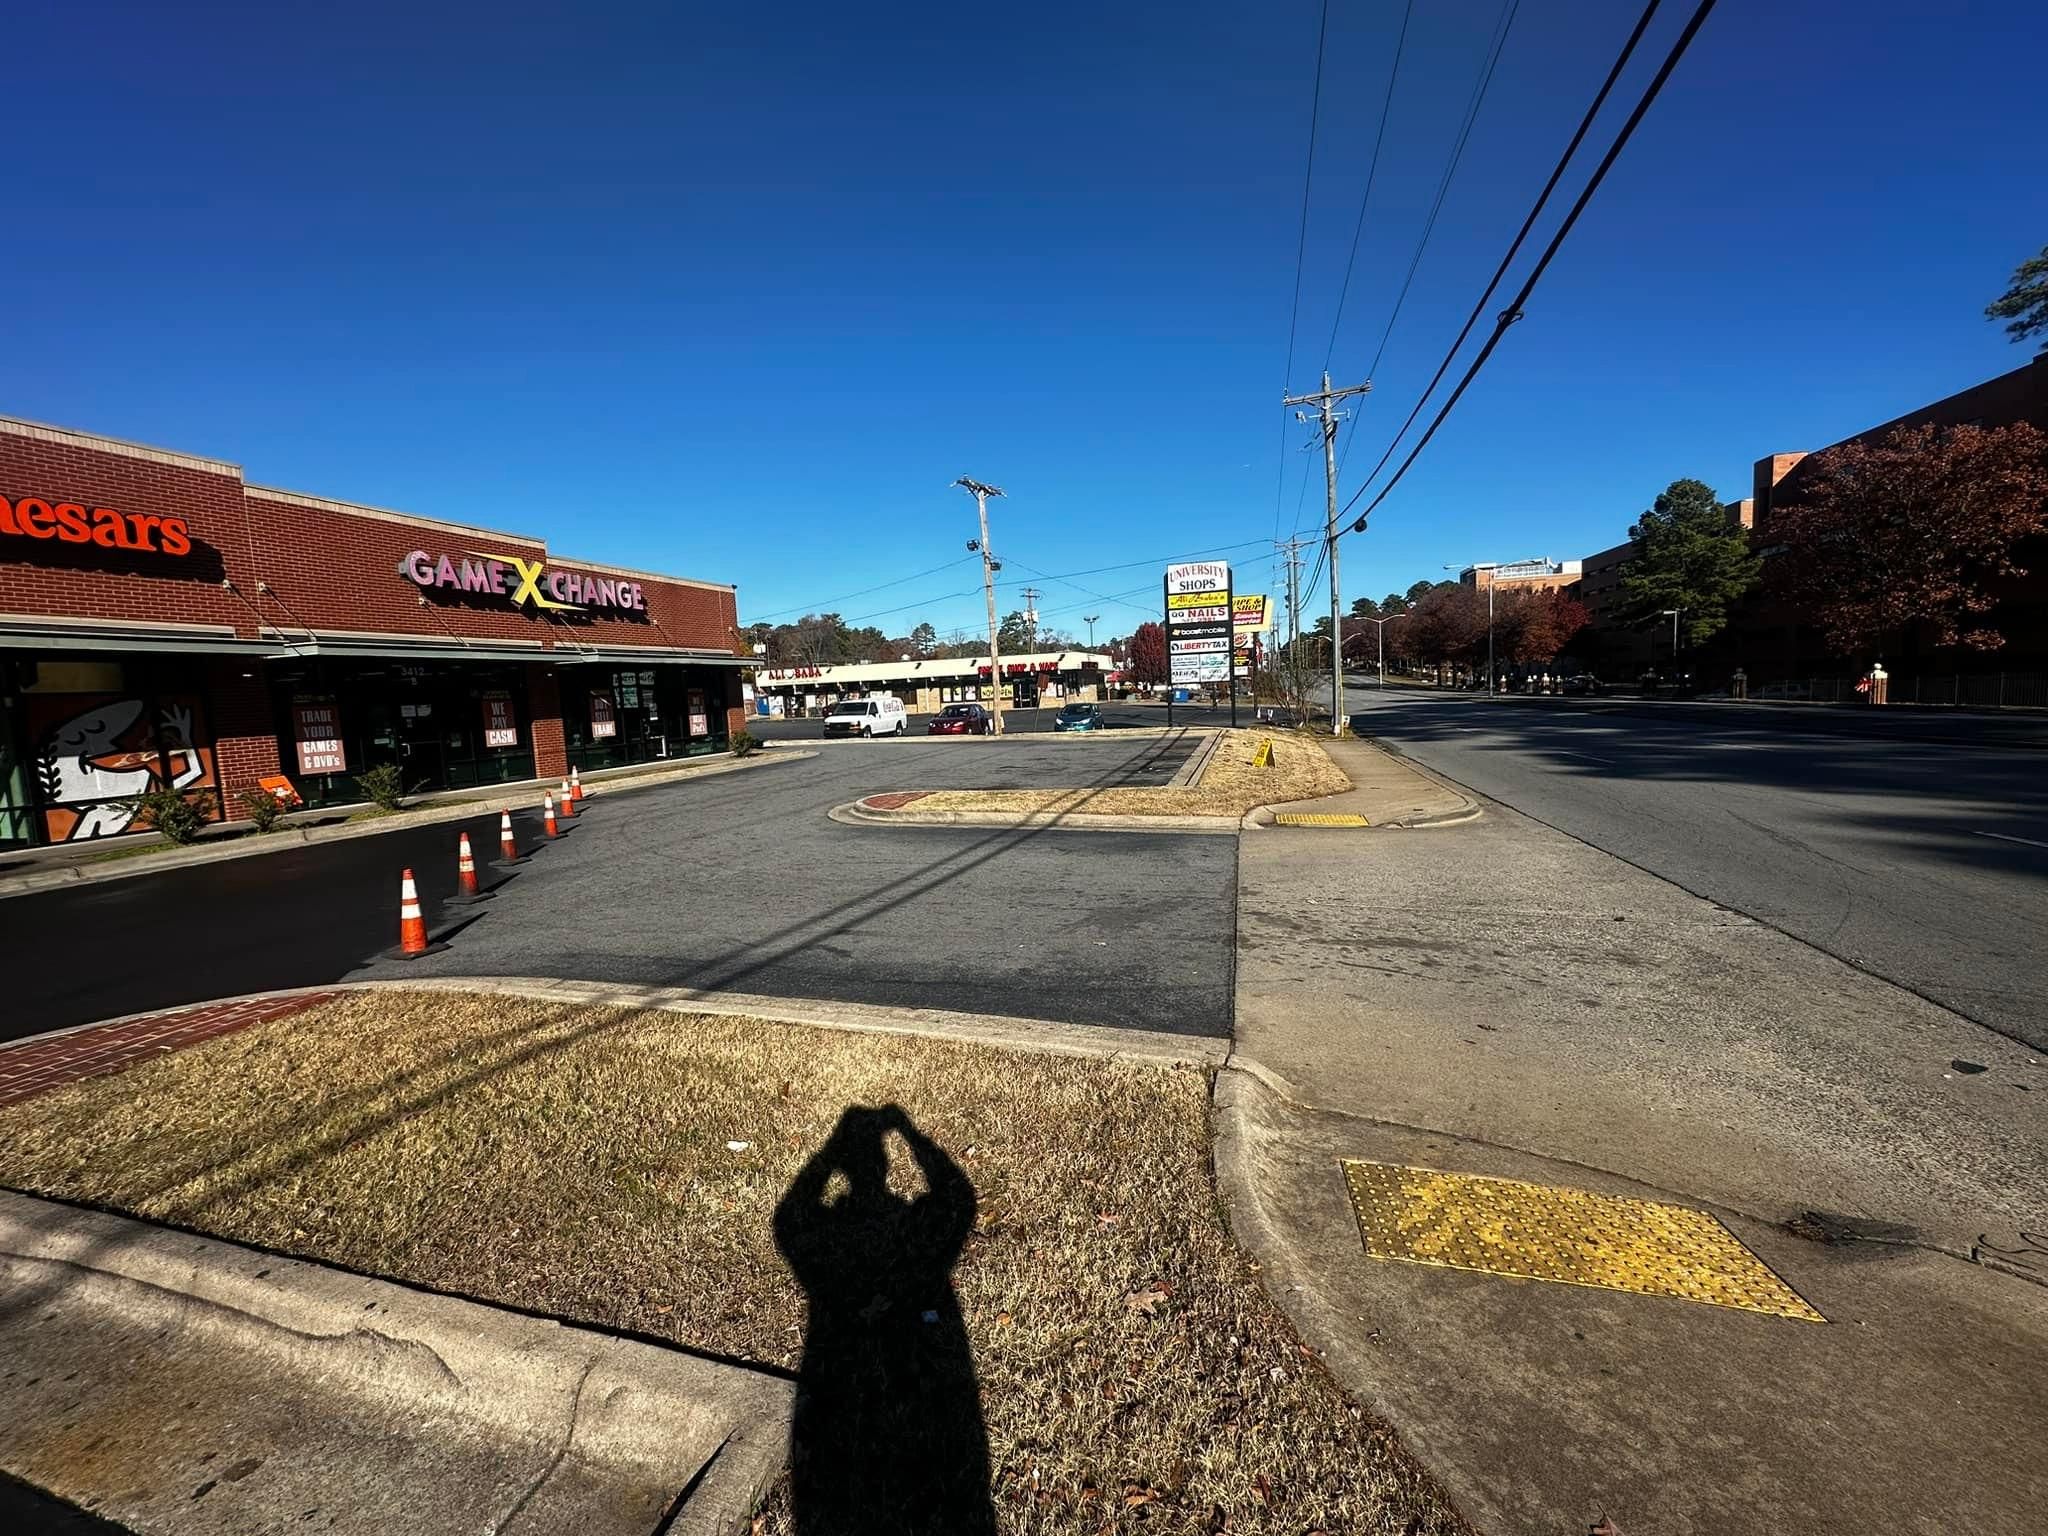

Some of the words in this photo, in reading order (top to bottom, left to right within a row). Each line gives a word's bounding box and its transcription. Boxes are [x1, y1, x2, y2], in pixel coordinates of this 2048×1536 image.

[1169, 564, 1225, 582] UNIVERSITY
[402, 550, 506, 595] GAME
[549, 571, 645, 611] CHANGE
[1179, 579, 1217, 591] SHOPS
[1187, 607, 1226, 618] NAILS
[401, 667, 425, 676] 3412
[768, 669, 785, 681] ALI
[794, 666, 822, 679] BABA
[1000, 687, 1013, 697] PEN
[491, 702, 505, 716] WE
[301, 710, 333, 723] TRADE
[491, 716, 508, 729] PAY
[303, 725, 334, 738] YOUR
[489, 730, 513, 745] CASH
[303, 740, 338, 754] GAMES
[304, 756, 313, 769] &
[313, 755, 340, 768] DVD's
